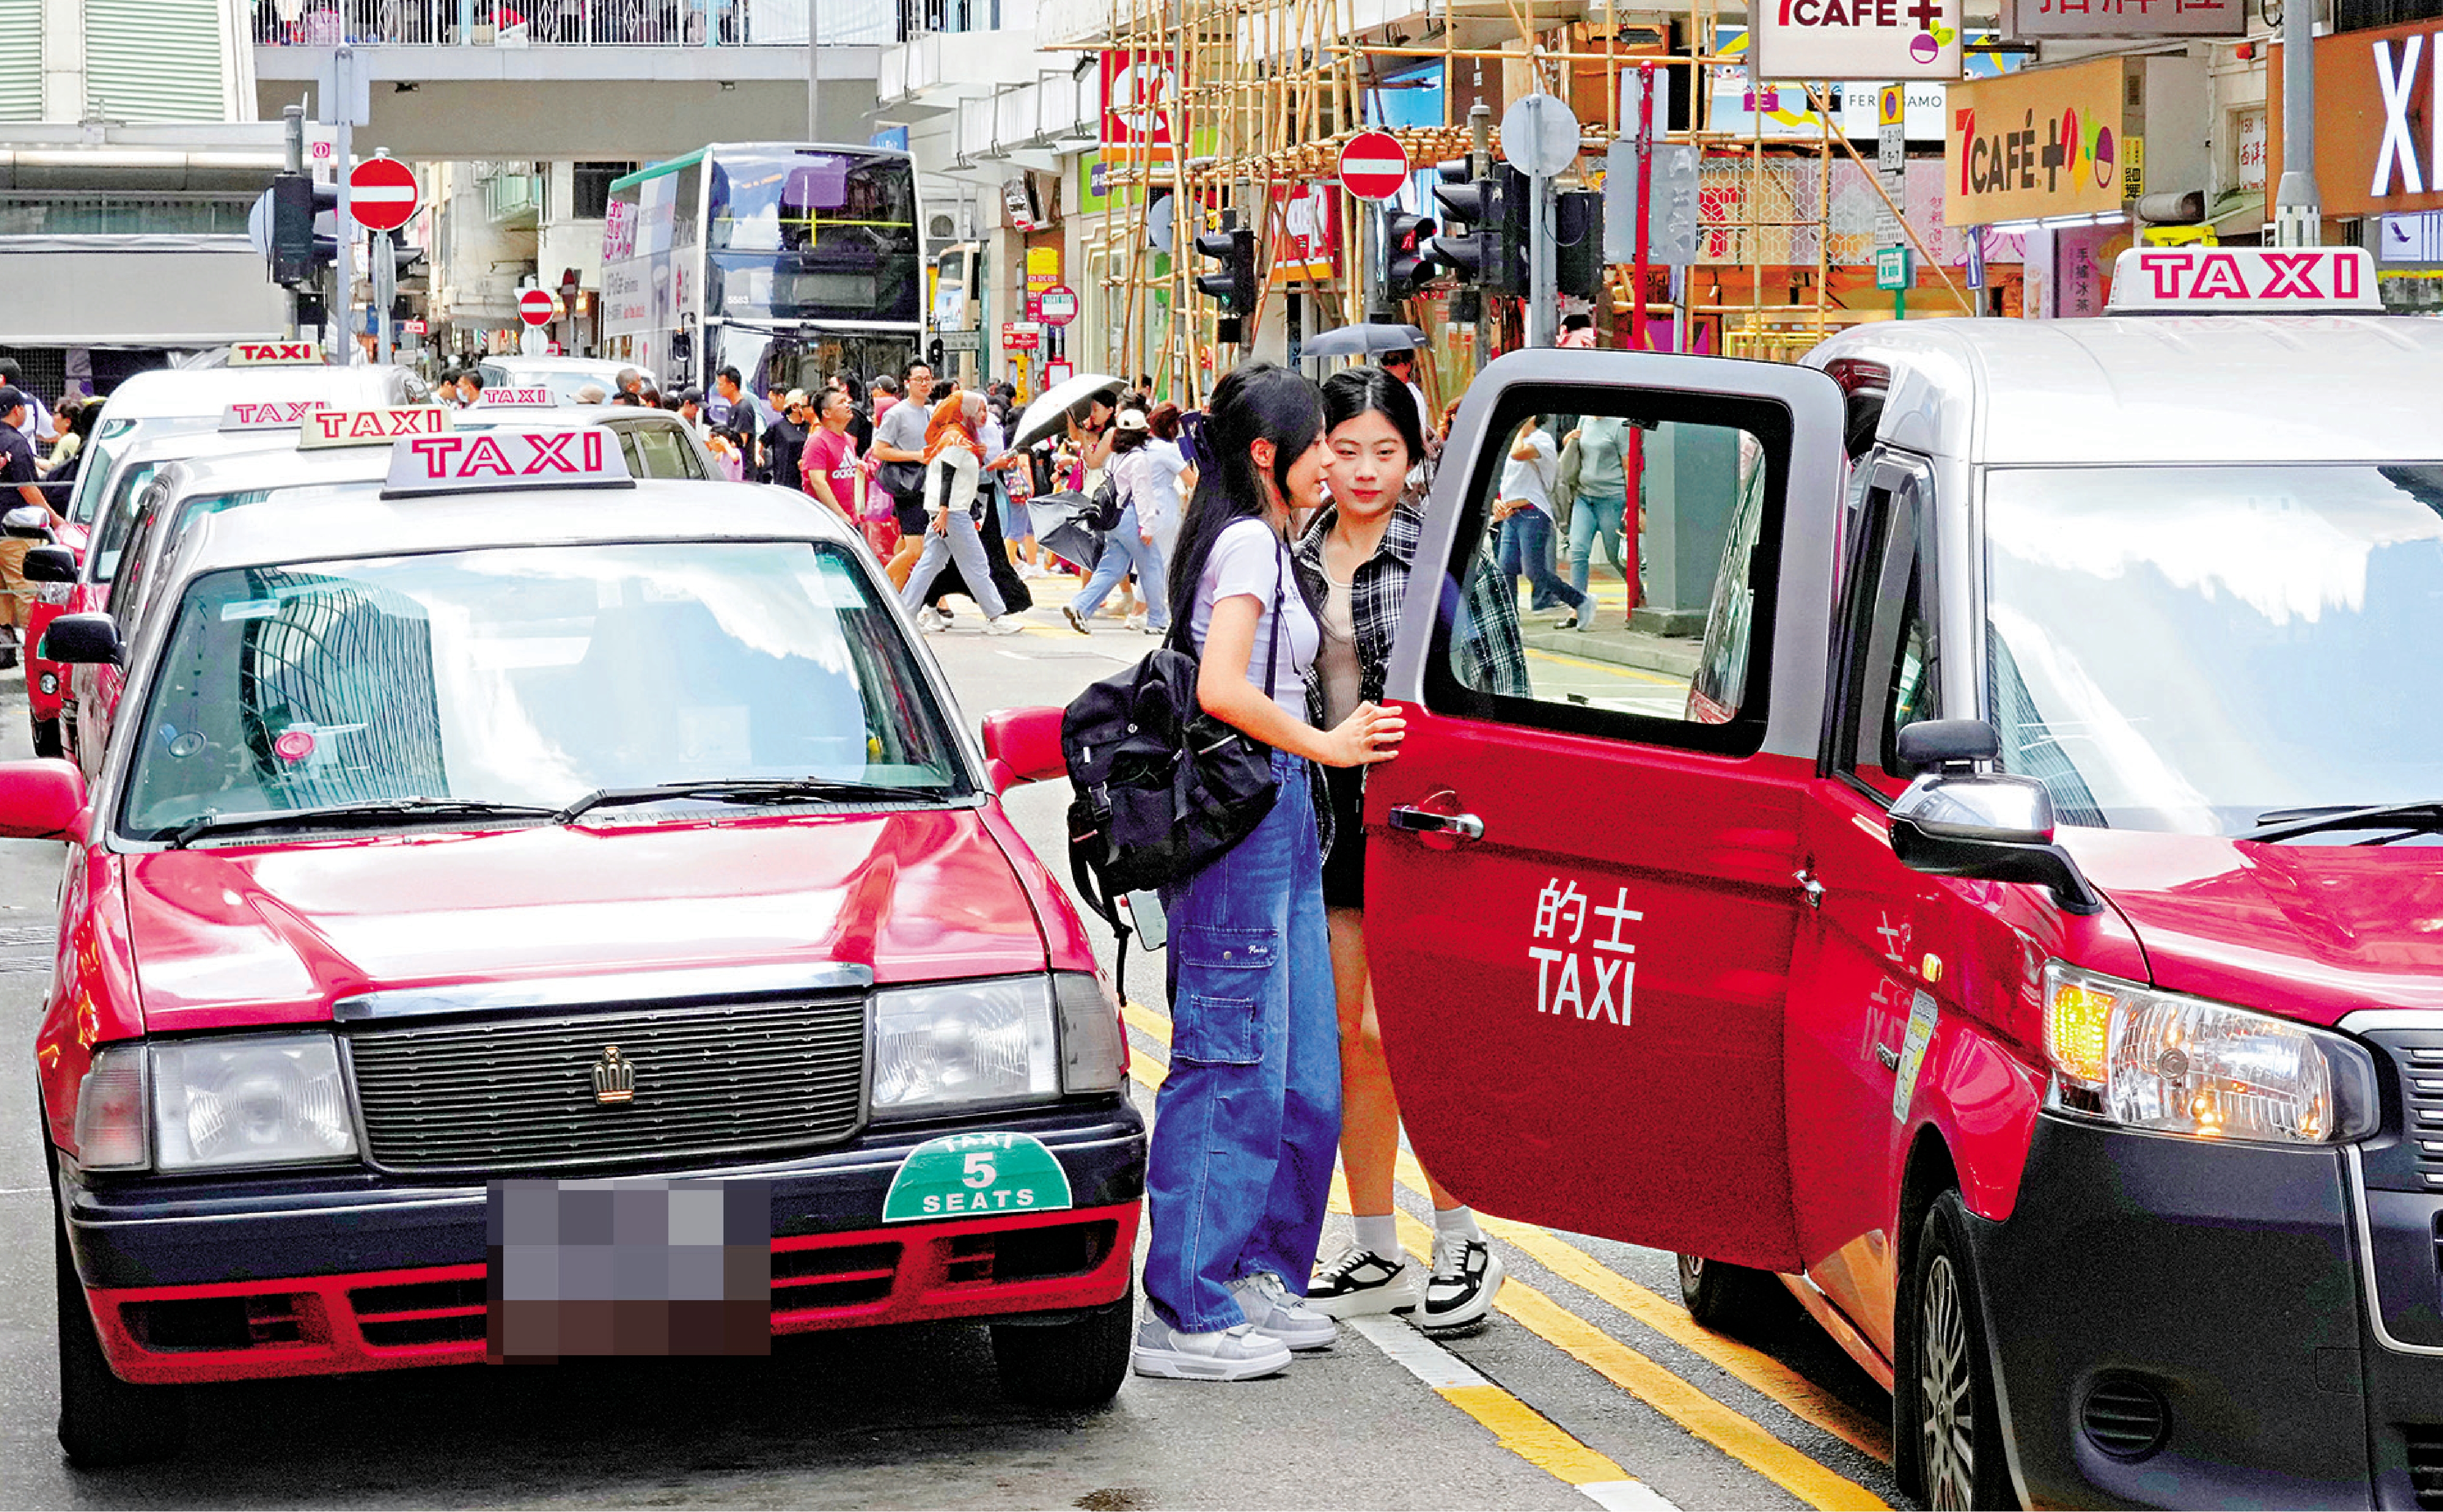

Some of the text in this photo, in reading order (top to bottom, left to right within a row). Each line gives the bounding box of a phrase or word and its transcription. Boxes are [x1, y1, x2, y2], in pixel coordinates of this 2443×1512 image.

[1849, 95, 1942, 107] FERAMO
[2141, 253, 2358, 300] TAXI
[238, 344, 311, 360] TAXI
[484, 389, 545, 404] TAXI
[316, 409, 442, 438] TAXI
[412, 431, 602, 478] TAXI
[1533, 878, 1644, 954] 的士
[1528, 946, 1636, 1027] TAXI
[963, 1152, 997, 1189] 5
[923, 1189, 1035, 1212] SEATS
